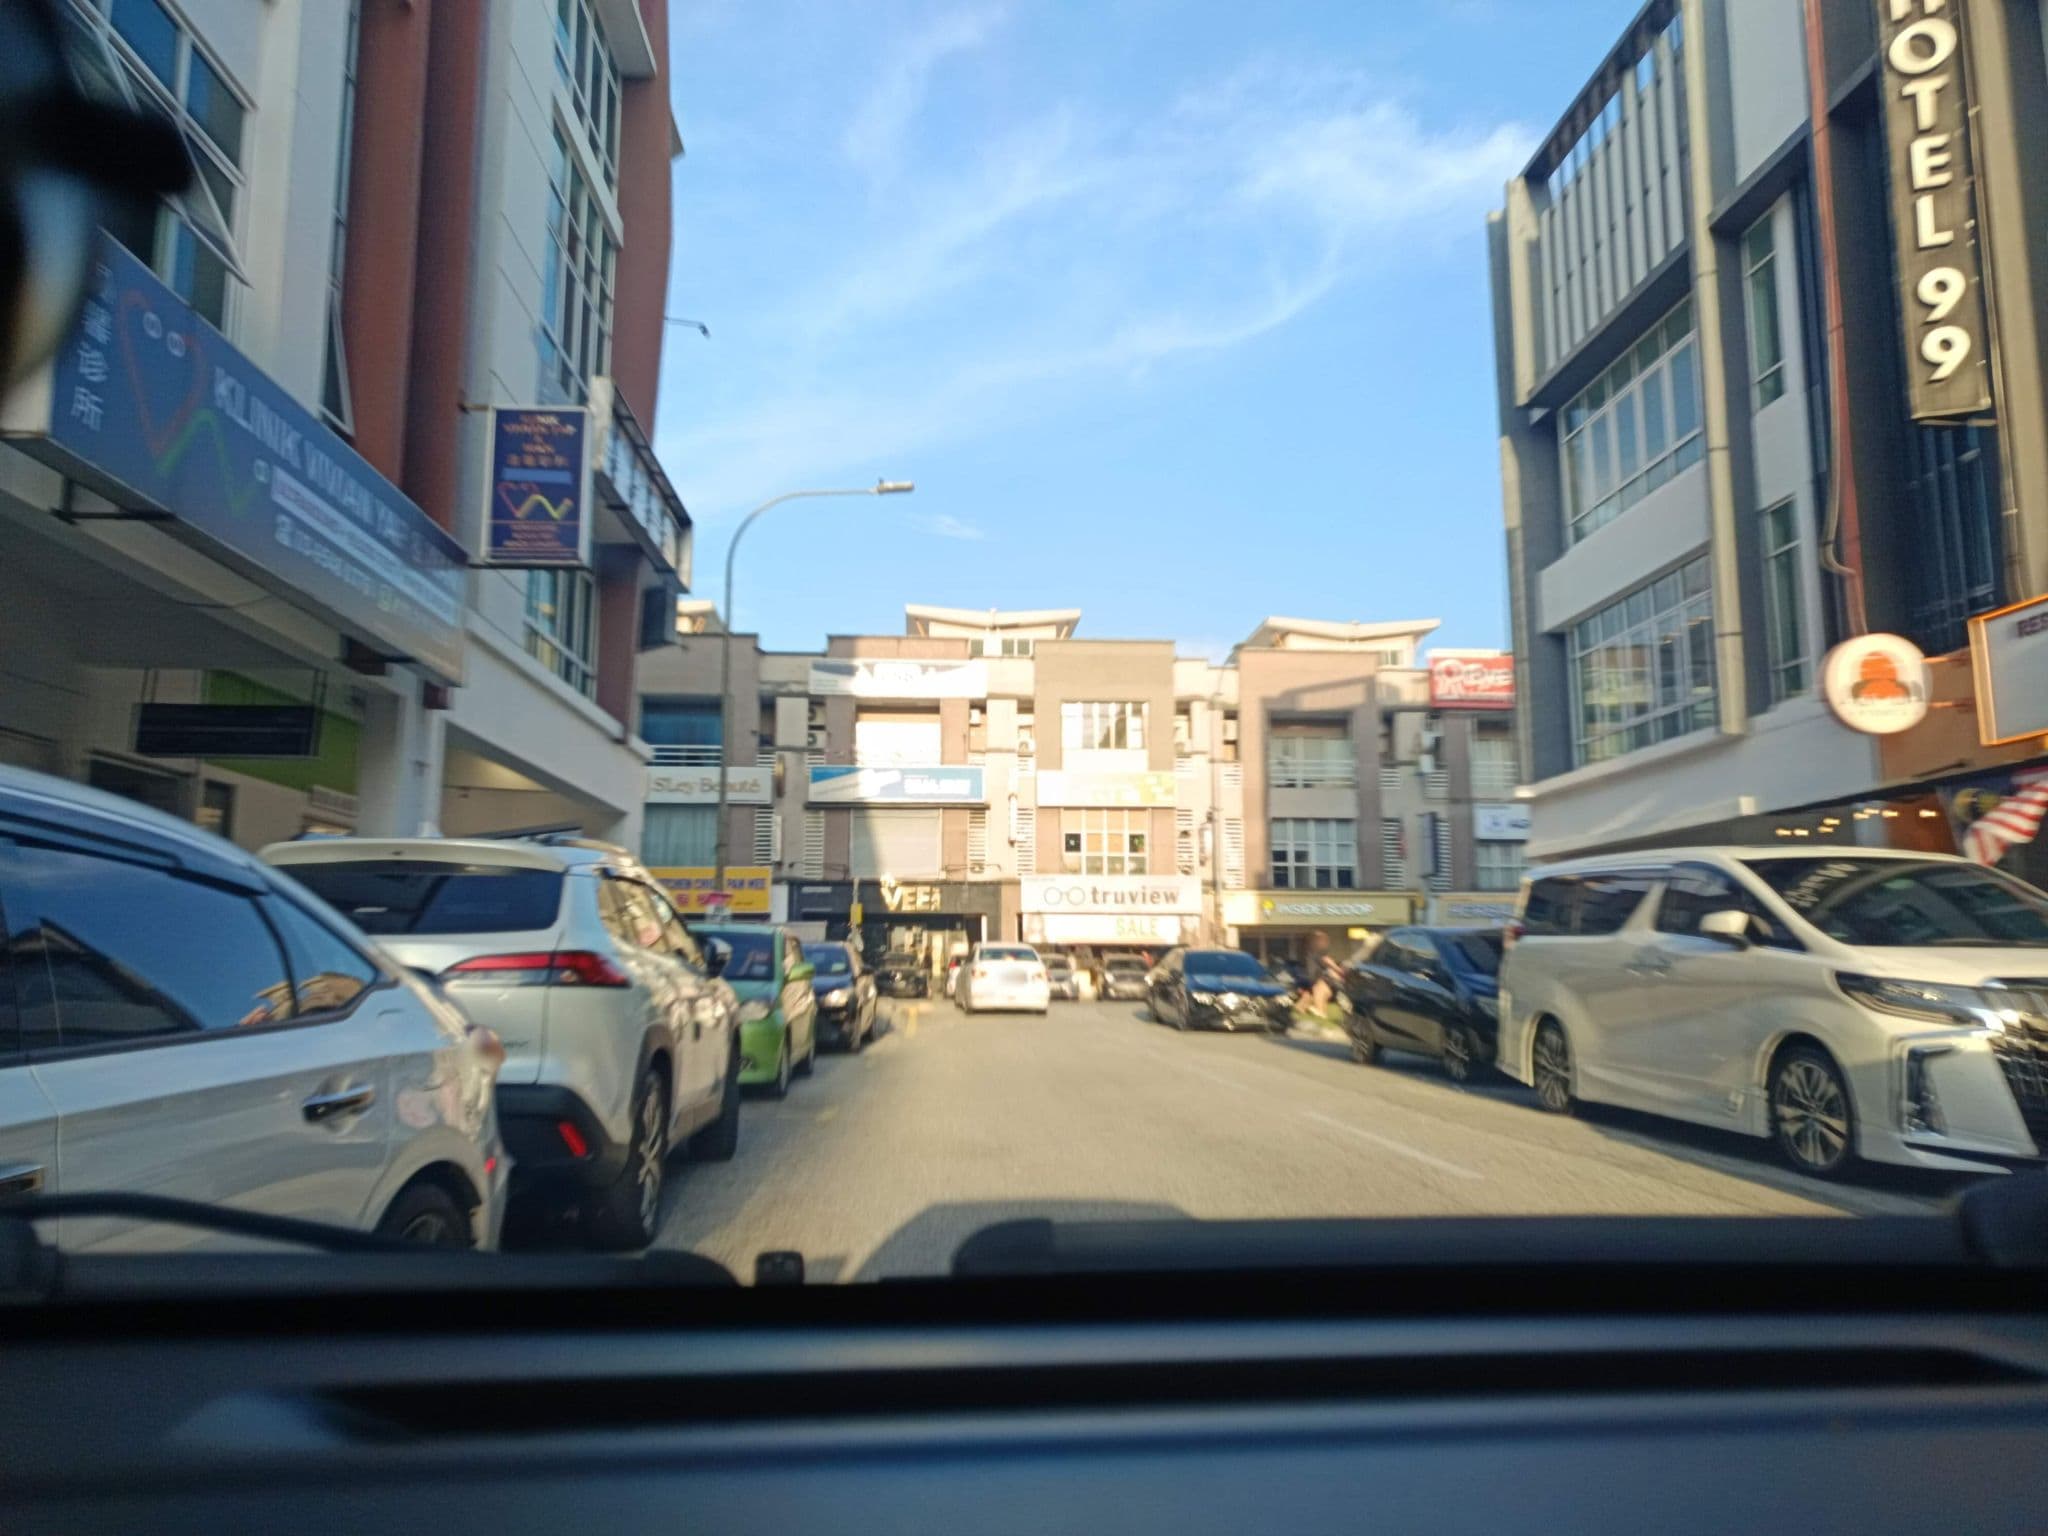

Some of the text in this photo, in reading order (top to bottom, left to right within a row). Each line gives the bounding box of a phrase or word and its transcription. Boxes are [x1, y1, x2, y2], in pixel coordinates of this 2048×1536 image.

[1917, 266, 1971, 382] 99
[1091, 885, 1179, 905] truview
[1115, 918, 1159, 937] SALE
